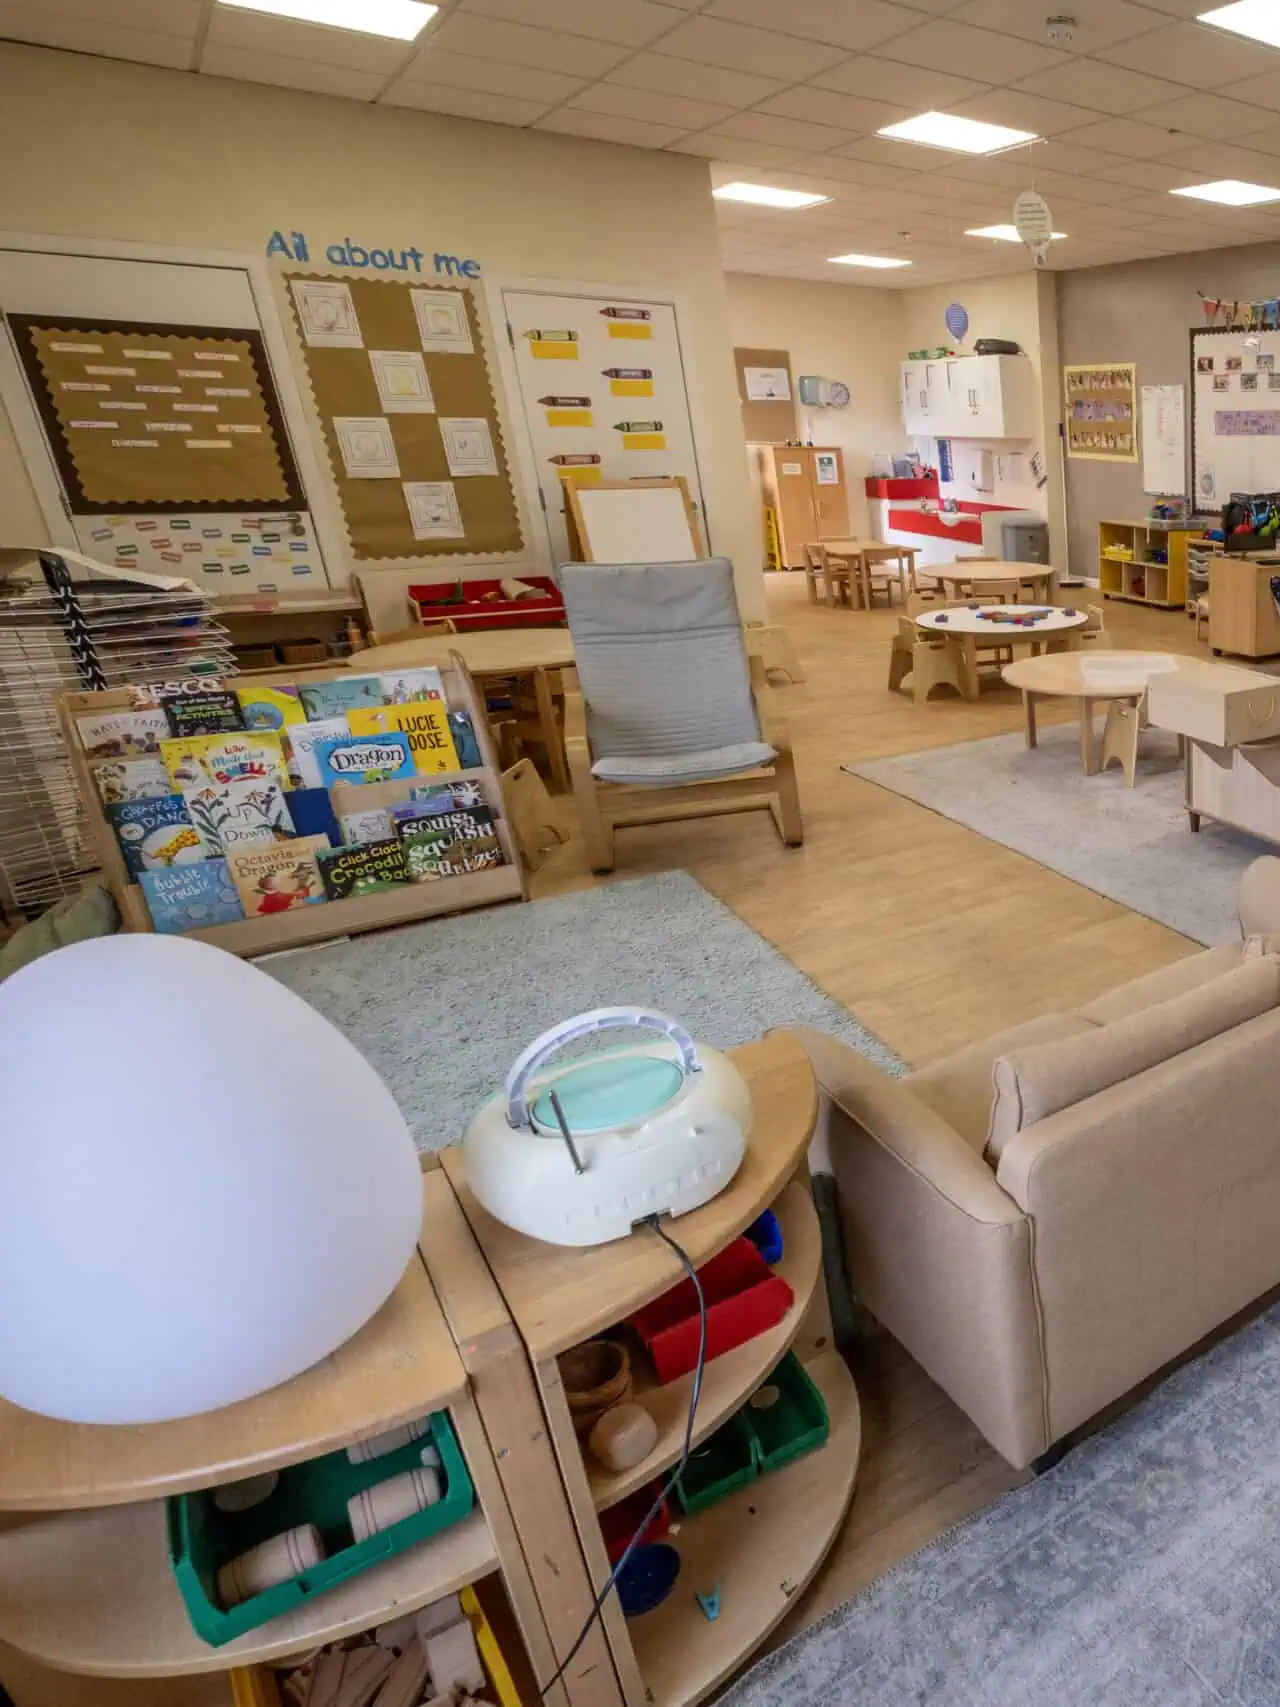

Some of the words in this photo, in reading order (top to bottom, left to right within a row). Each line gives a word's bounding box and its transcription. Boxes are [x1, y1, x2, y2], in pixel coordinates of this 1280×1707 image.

[266, 229, 309, 262] All
[326, 237, 424, 272] about
[433, 253, 481, 279] me
[133, 678, 224, 700] TESCO
[397, 714, 440, 732] LUCIE
[334, 749, 403, 770] Dragon
[338, 851, 371, 868] Click
